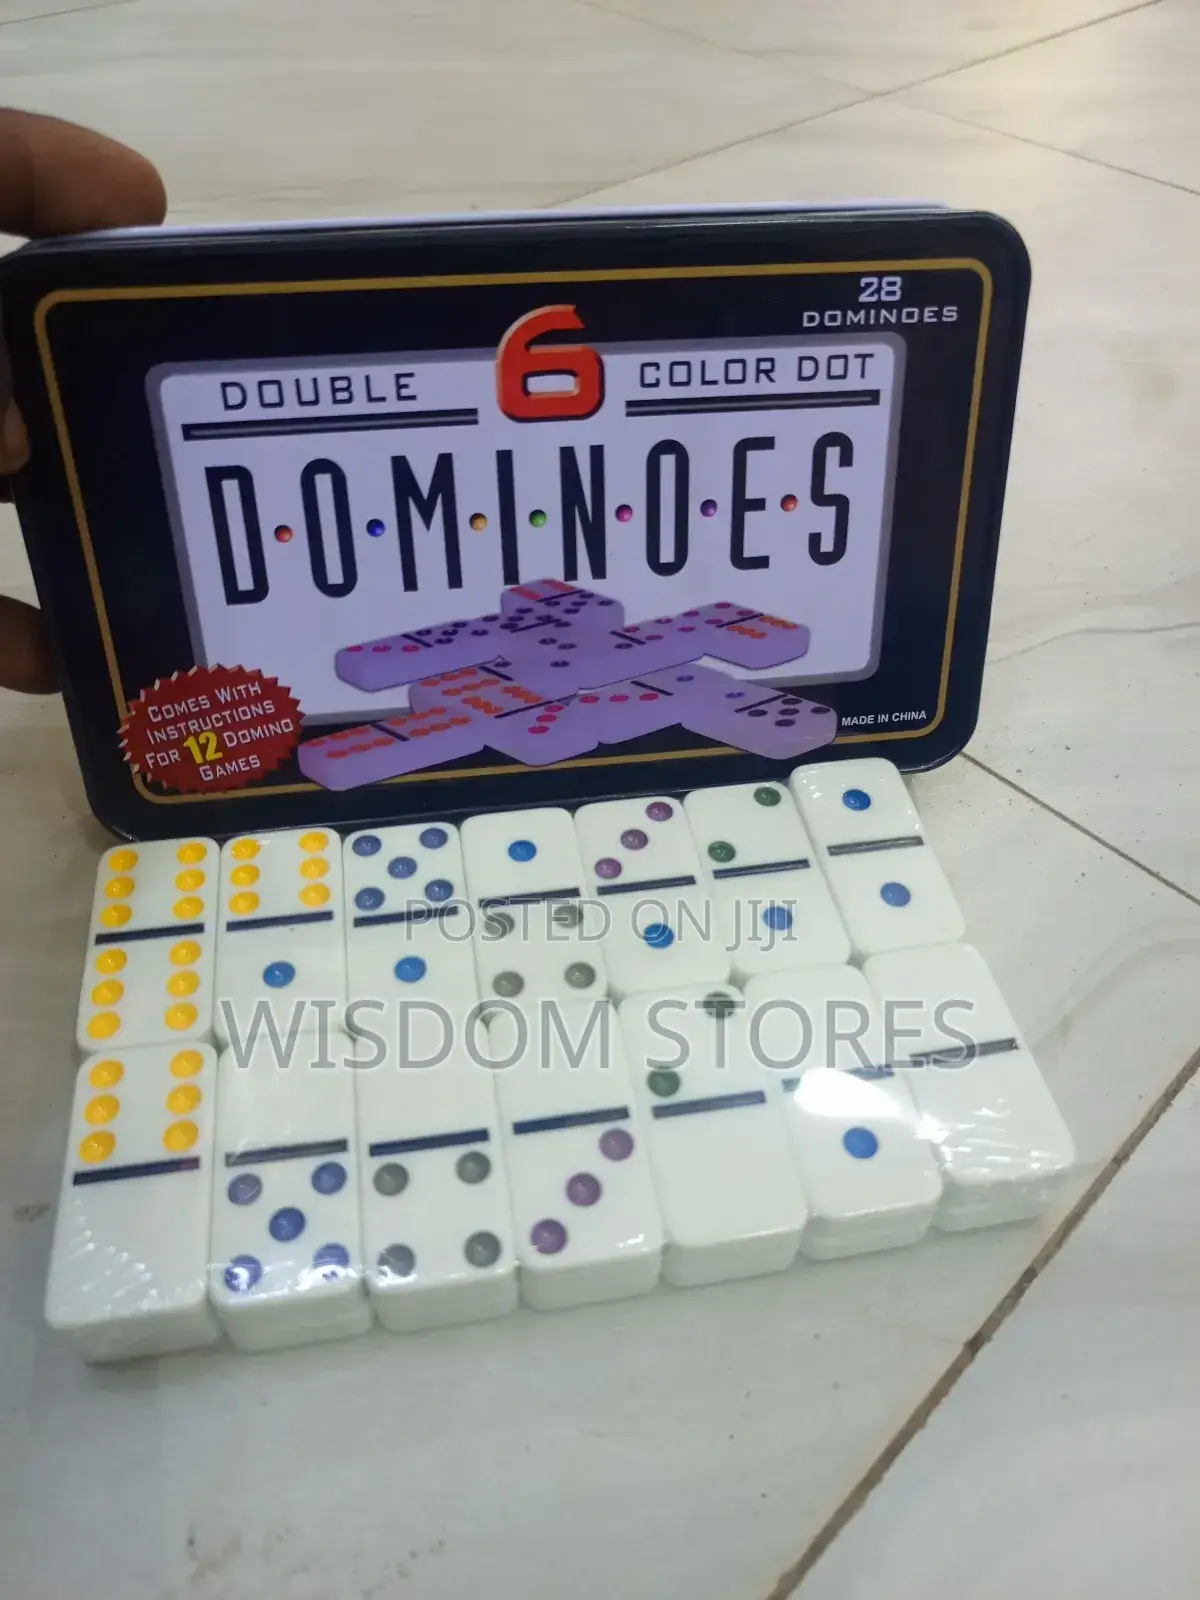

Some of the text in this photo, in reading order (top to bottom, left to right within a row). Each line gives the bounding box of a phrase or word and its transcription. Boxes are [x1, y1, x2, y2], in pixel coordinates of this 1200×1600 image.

[857, 276, 903, 303] 28
[802, 305, 959, 329] DOMINOES
[220, 304, 876, 423] DOUBLE 6 COLOR DOT
[841, 710, 927, 726] MADE IN CHINA
[183, 731, 223, 765] 12
